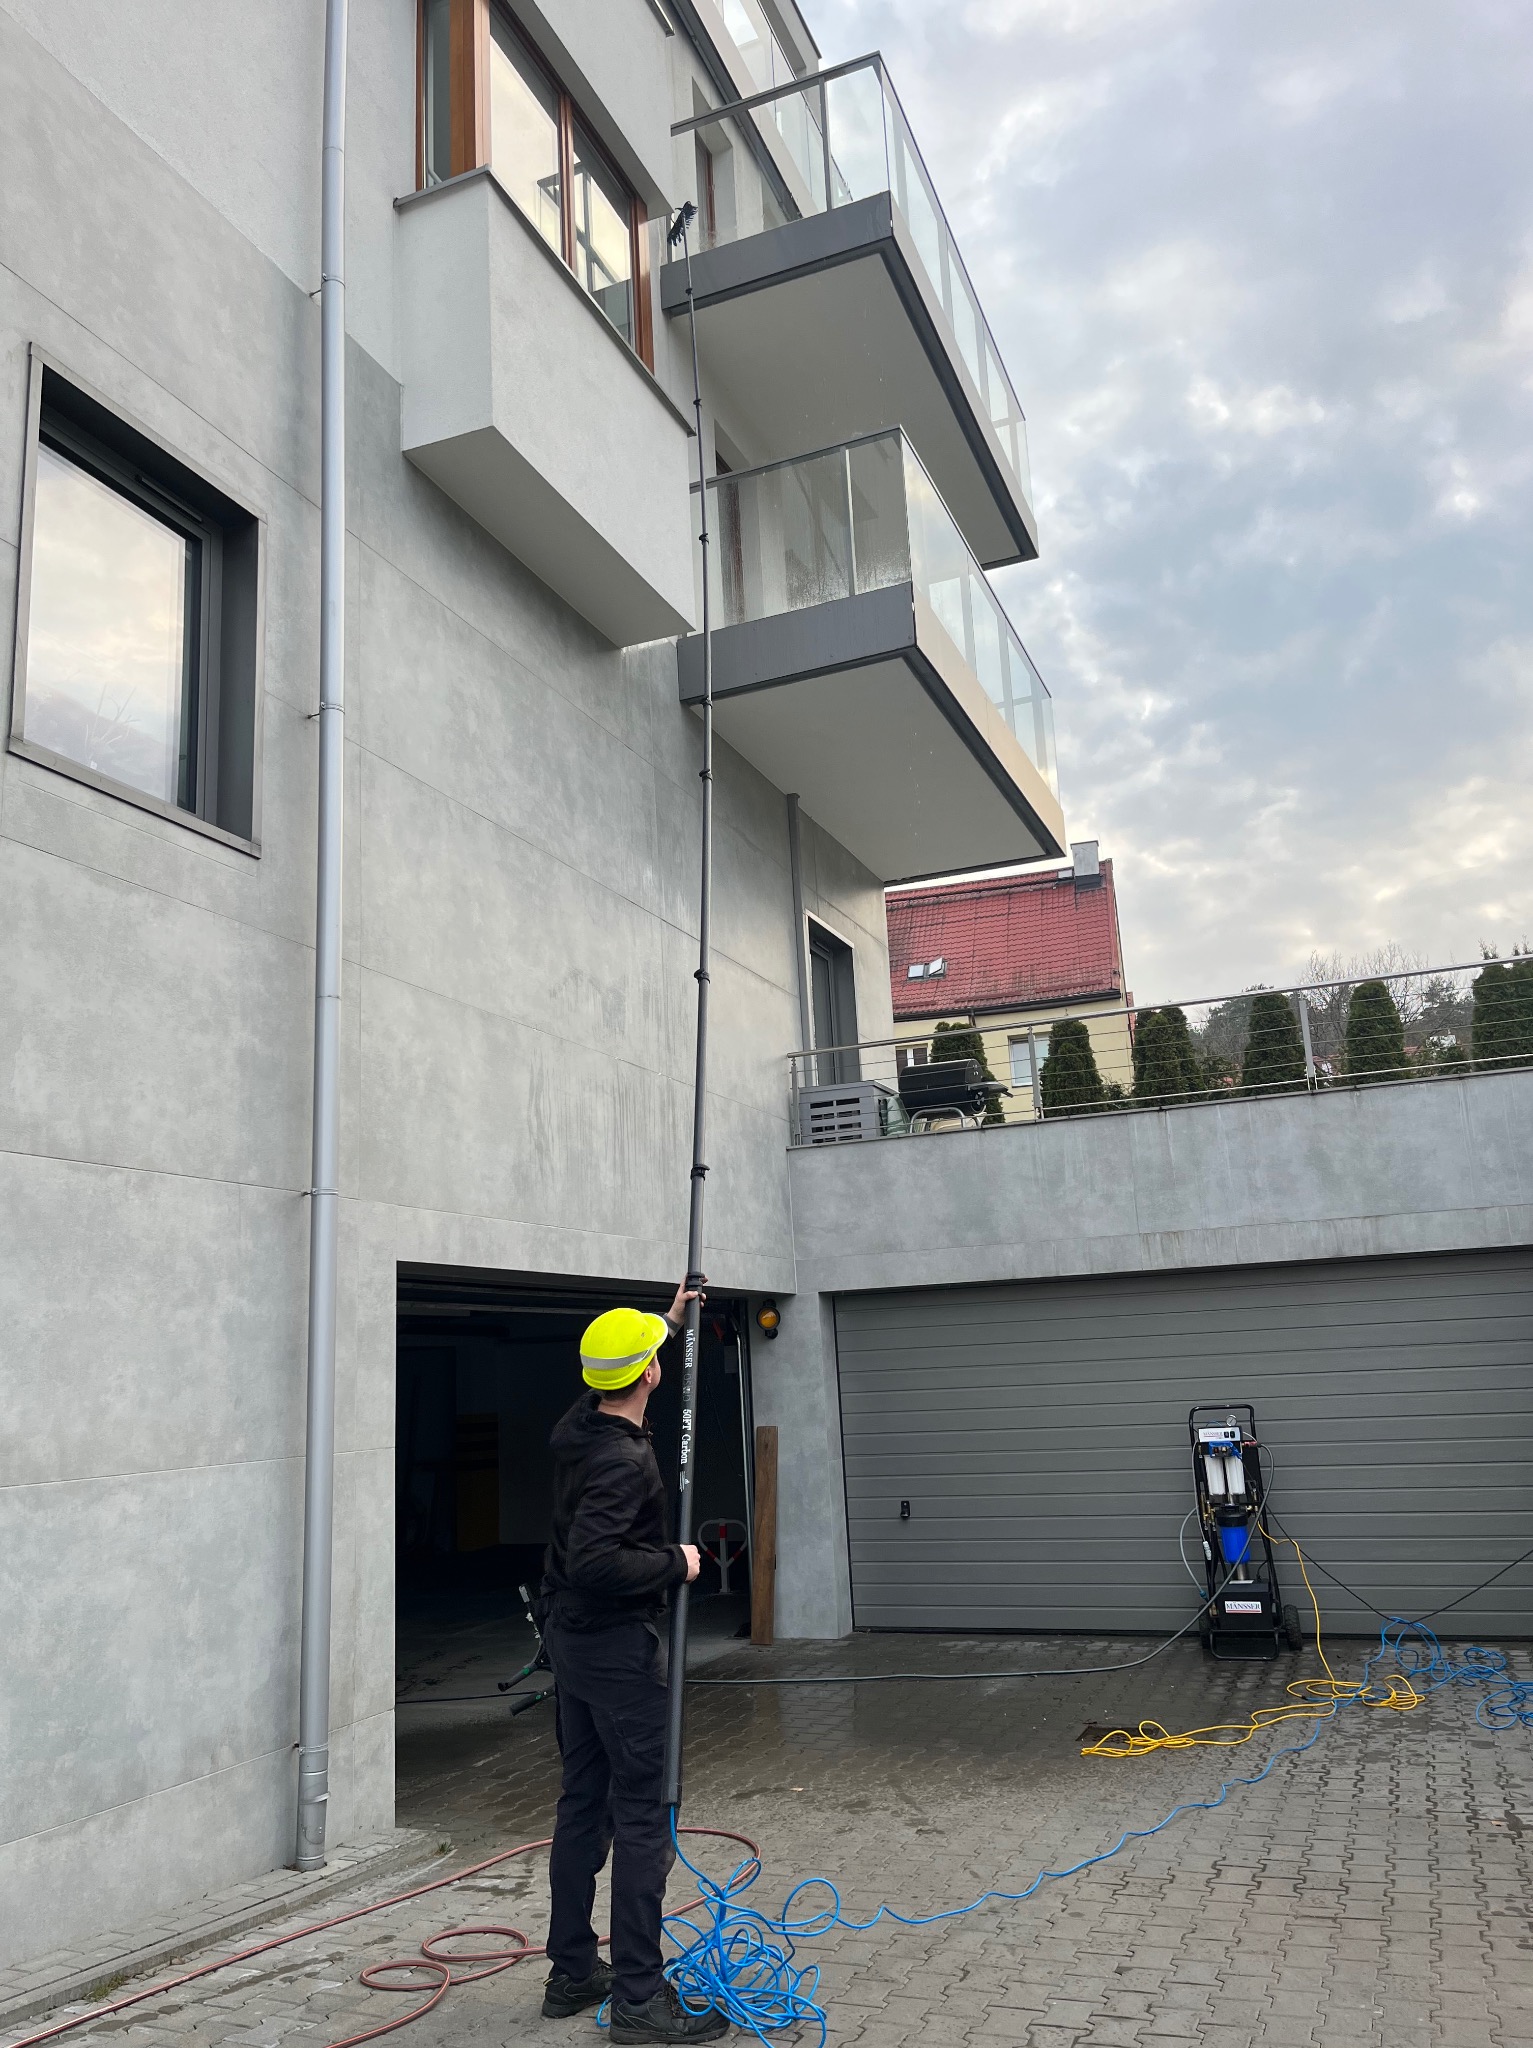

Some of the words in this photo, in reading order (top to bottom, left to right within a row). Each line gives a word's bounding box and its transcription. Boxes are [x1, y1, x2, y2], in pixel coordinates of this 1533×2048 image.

[684, 1329, 696, 1369] MÄNSSER
[682, 1408, 692, 1431] 50FT
[680, 1433, 691, 1465] Carbon
